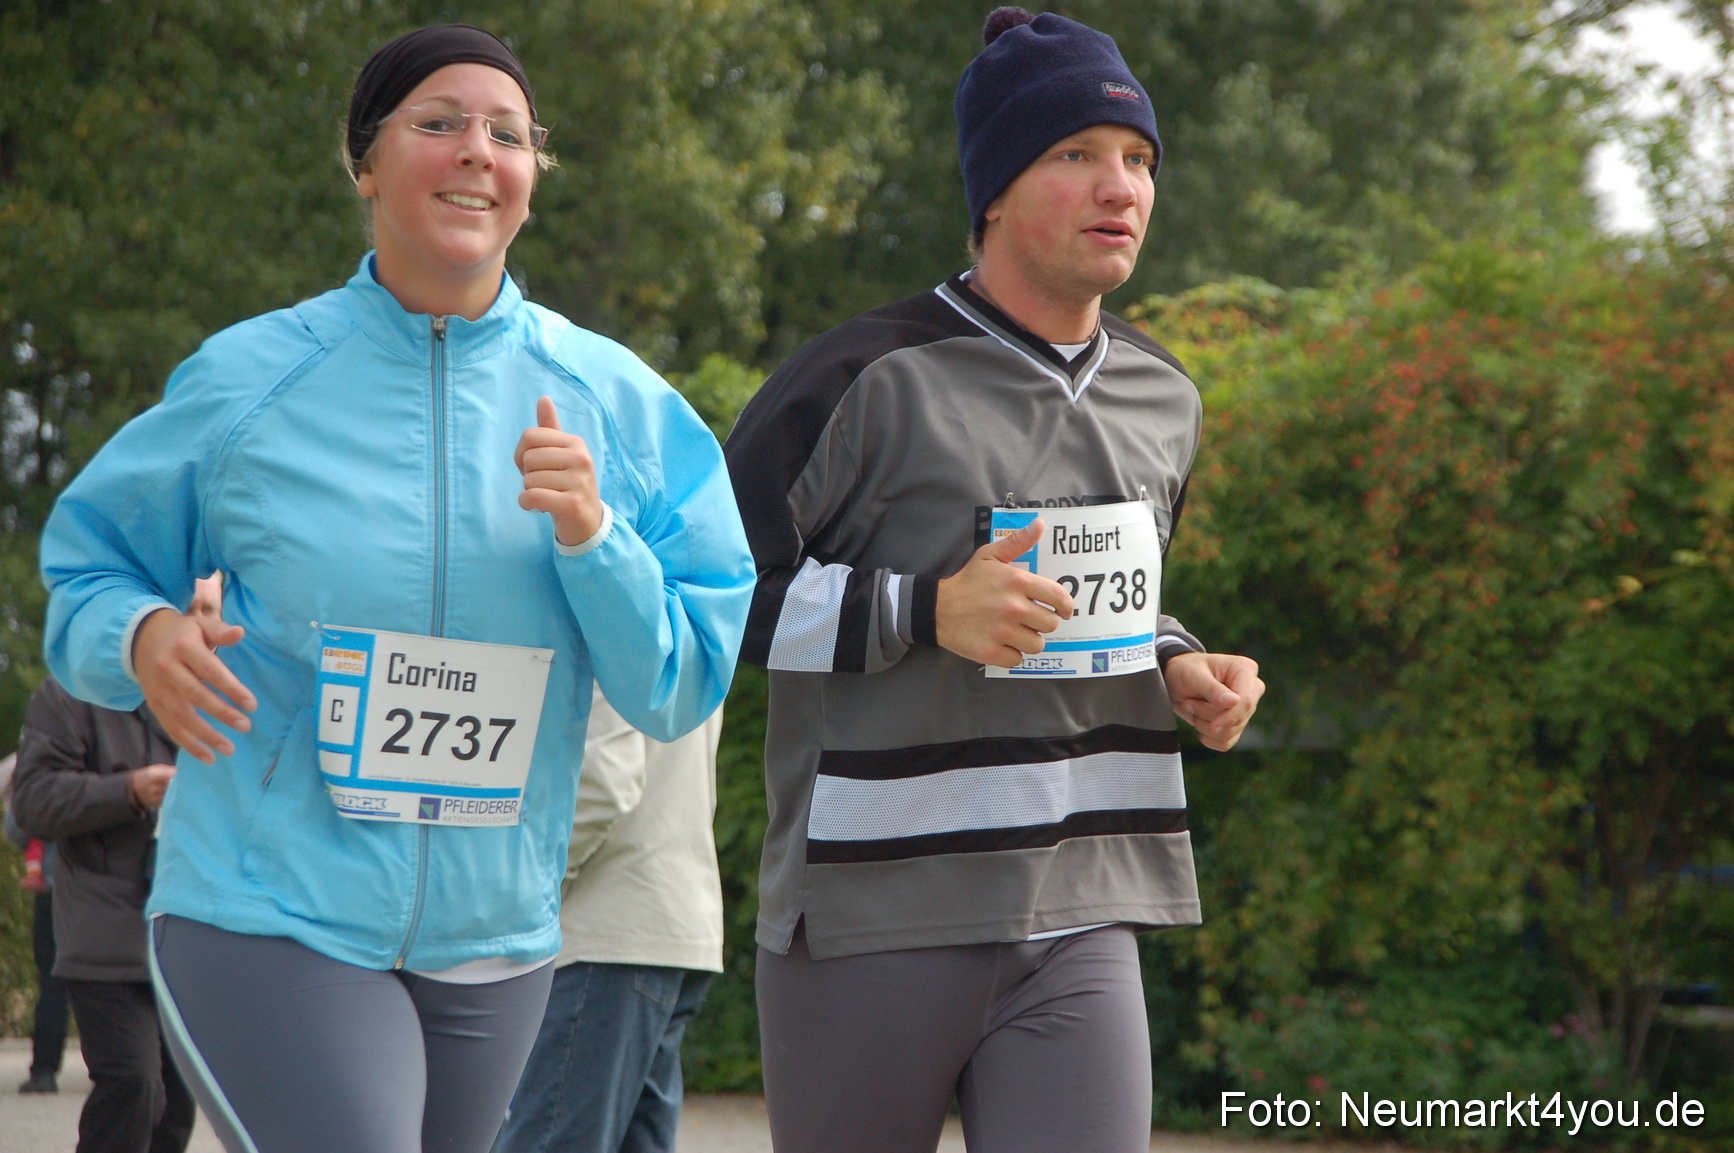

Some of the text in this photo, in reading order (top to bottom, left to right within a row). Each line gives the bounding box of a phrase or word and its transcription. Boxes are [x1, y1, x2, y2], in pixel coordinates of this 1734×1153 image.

[1052, 524, 1121, 555] Robert
[1056, 568, 1147, 617] 2738
[387, 652, 477, 693] Corina
[1014, 658, 1063, 670] OCK
[330, 699, 344, 723] C
[380, 708, 517, 762] 2737
[444, 799, 518, 815] PFLEIDERER
